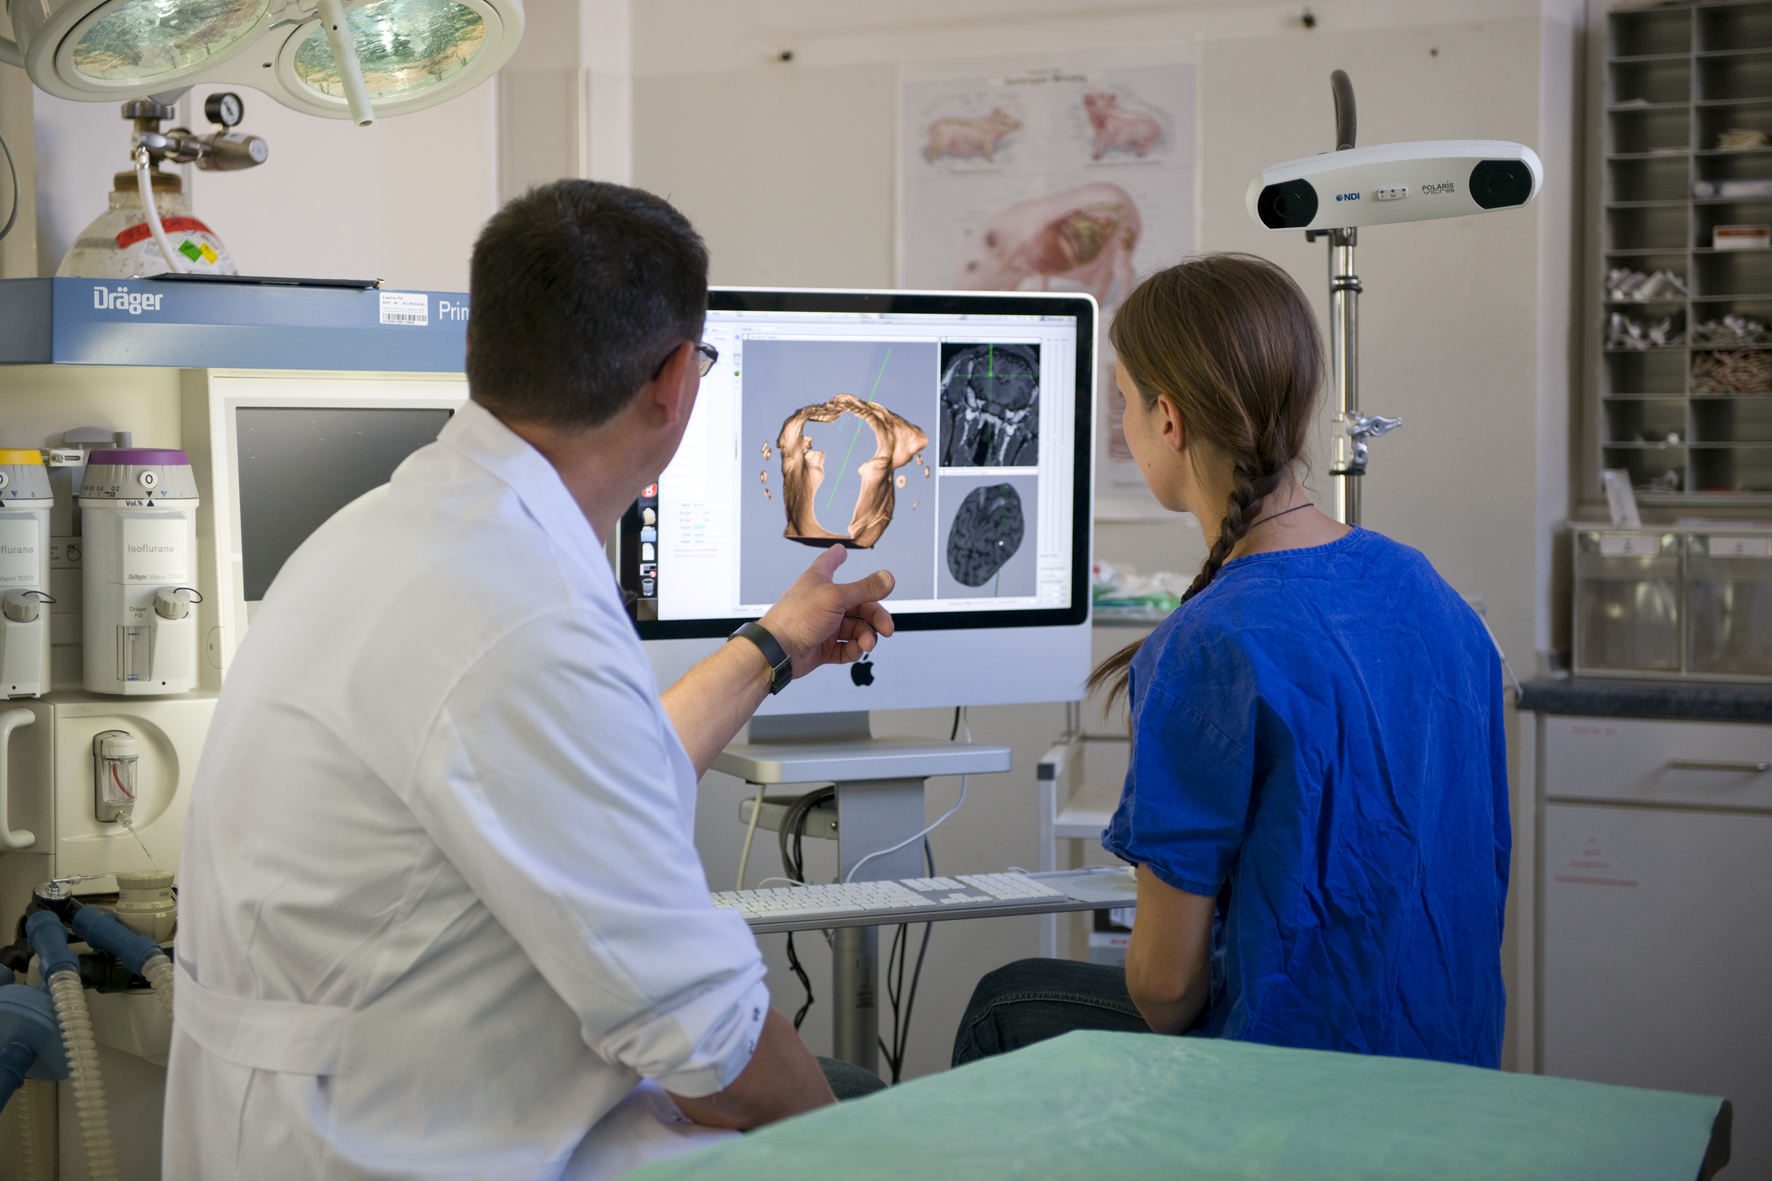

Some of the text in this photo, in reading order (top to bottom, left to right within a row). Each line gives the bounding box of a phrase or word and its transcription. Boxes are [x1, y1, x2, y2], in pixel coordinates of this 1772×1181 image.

[1344, 192, 1360, 201] NDI
[94, 286, 163, 315] Dräger
[0, 545, 34, 554] flurane
[127, 544, 175, 553] Isoflurane
